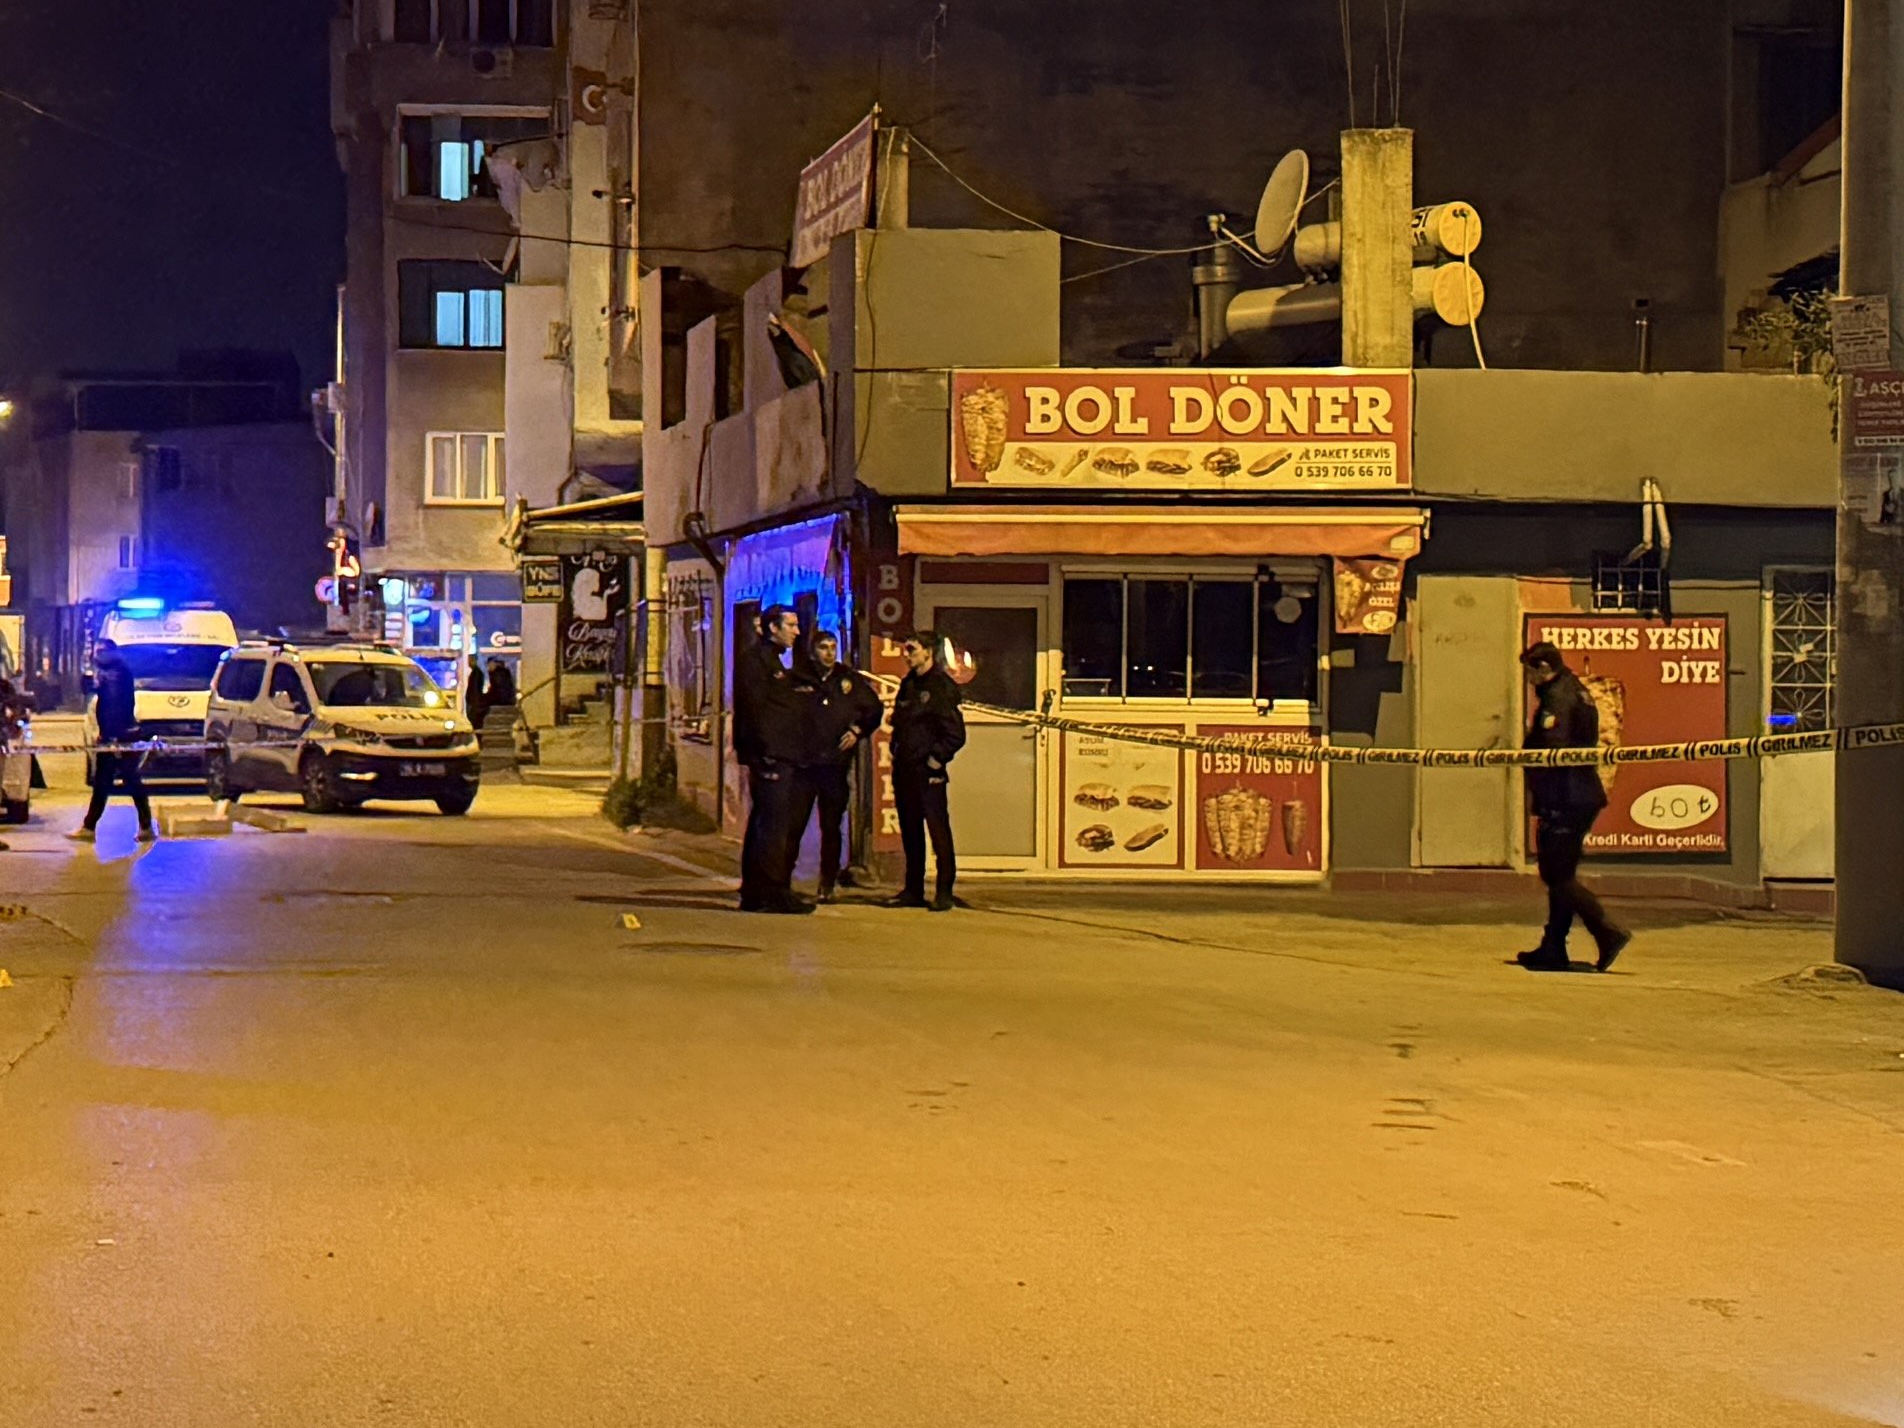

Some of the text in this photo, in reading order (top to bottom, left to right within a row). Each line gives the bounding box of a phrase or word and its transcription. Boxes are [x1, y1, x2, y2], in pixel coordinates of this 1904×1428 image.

[1024, 375, 1393, 435] BOL DÖNER
[1314, 446, 1391, 459] PAKET SERVİS
[1295, 466, 1392, 477] 0 539 706 66 70
[1541, 622, 1721, 650] HERKES YESİN
[1661, 655, 1721, 684] DİYE
[1201, 753, 1211, 773] 0
[1214, 753, 1241, 773] 539
